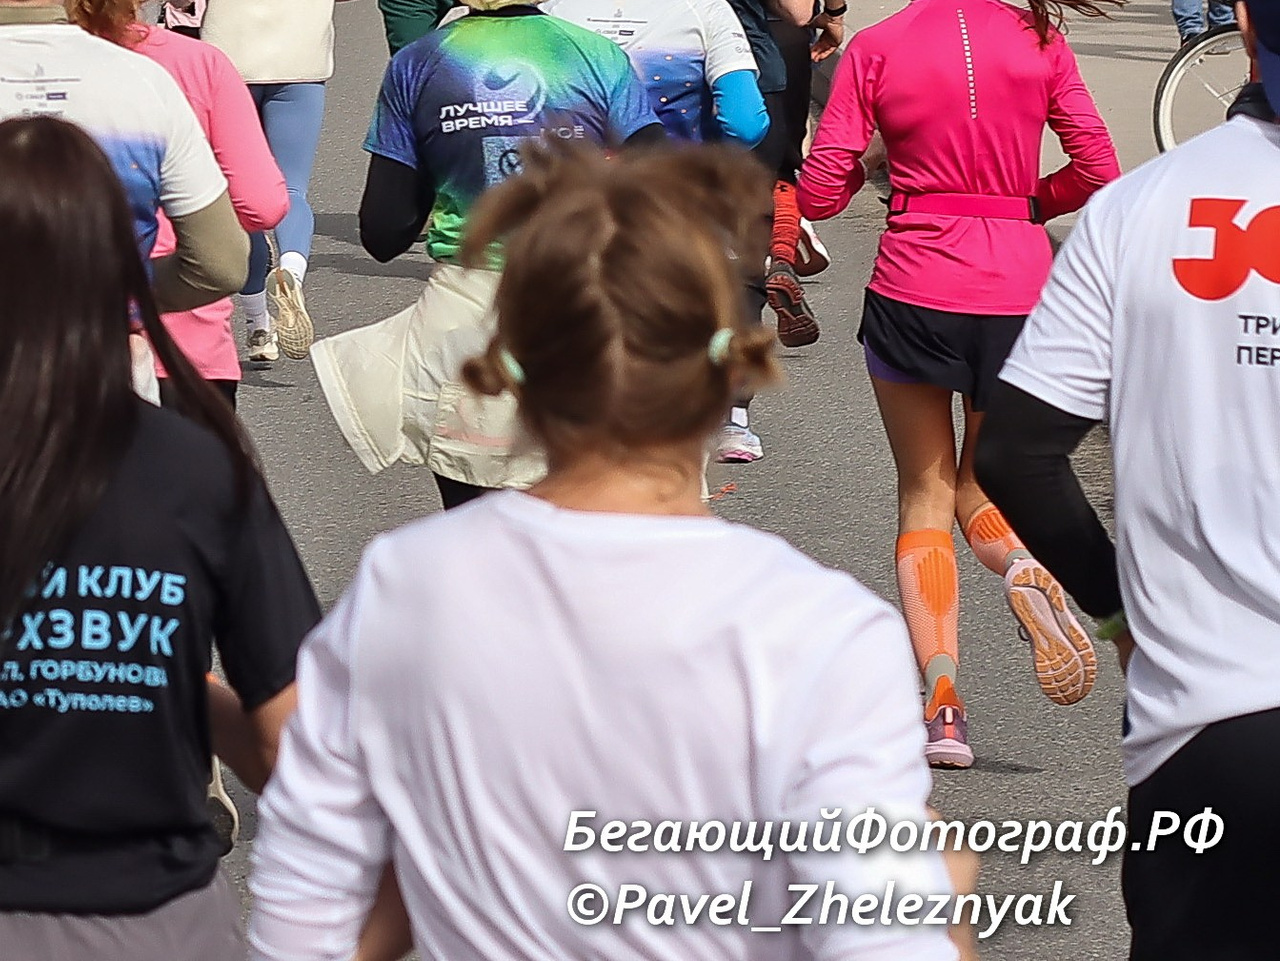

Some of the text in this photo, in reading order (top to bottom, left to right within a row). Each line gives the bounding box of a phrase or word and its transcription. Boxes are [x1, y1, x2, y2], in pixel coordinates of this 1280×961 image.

[439, 100, 528, 120] ЛУЧШЕЕ
[441, 115, 513, 133] ВРЕМЯ
[77, 564, 187, 606] КЛУБ
[17, 608, 180, 657] ХЗВУК
